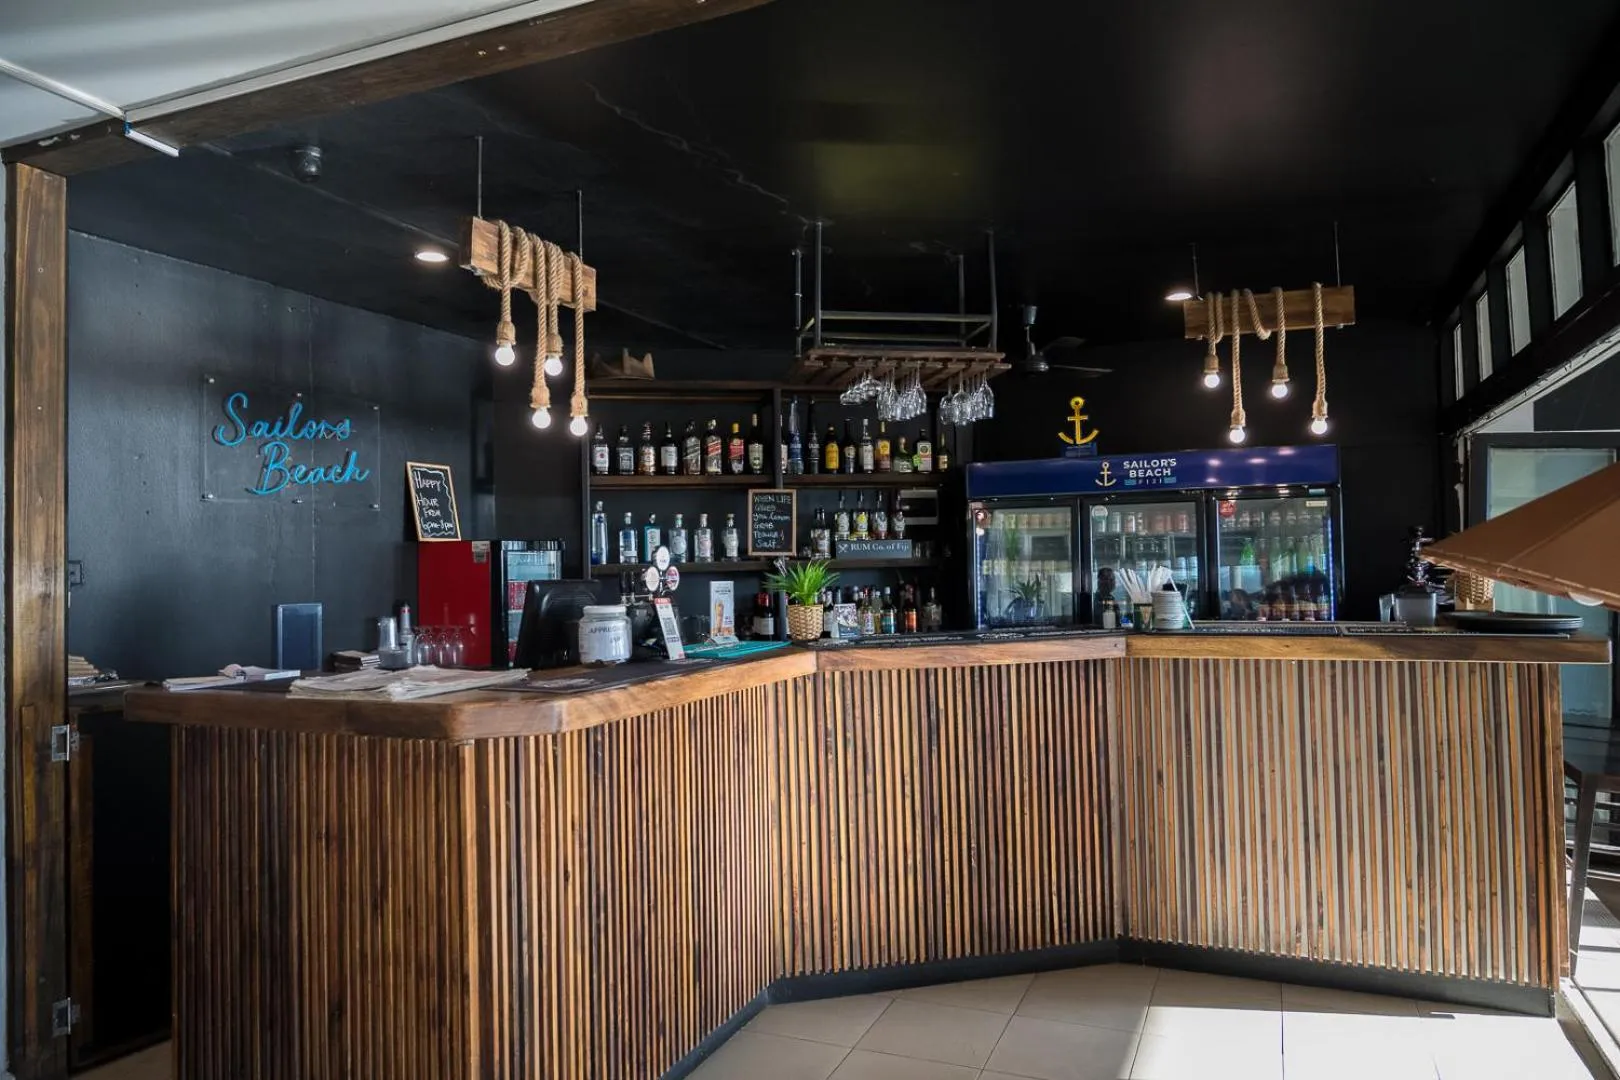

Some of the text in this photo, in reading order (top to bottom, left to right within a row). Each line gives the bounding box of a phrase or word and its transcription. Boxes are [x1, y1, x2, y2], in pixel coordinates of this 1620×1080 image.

[217, 392, 351, 446] Sailors
[250, 440, 370, 494] Beach
[1123, 458, 1177, 469] SAILOR'S
[1129, 468, 1171, 478] BEACH
[413, 471, 441, 492] HAPPY
[1138, 478, 1162, 486] FIJI
[415, 492, 440, 508] HOUR
[850, 543, 870, 551] RUM
[886, 543, 895, 551] of
